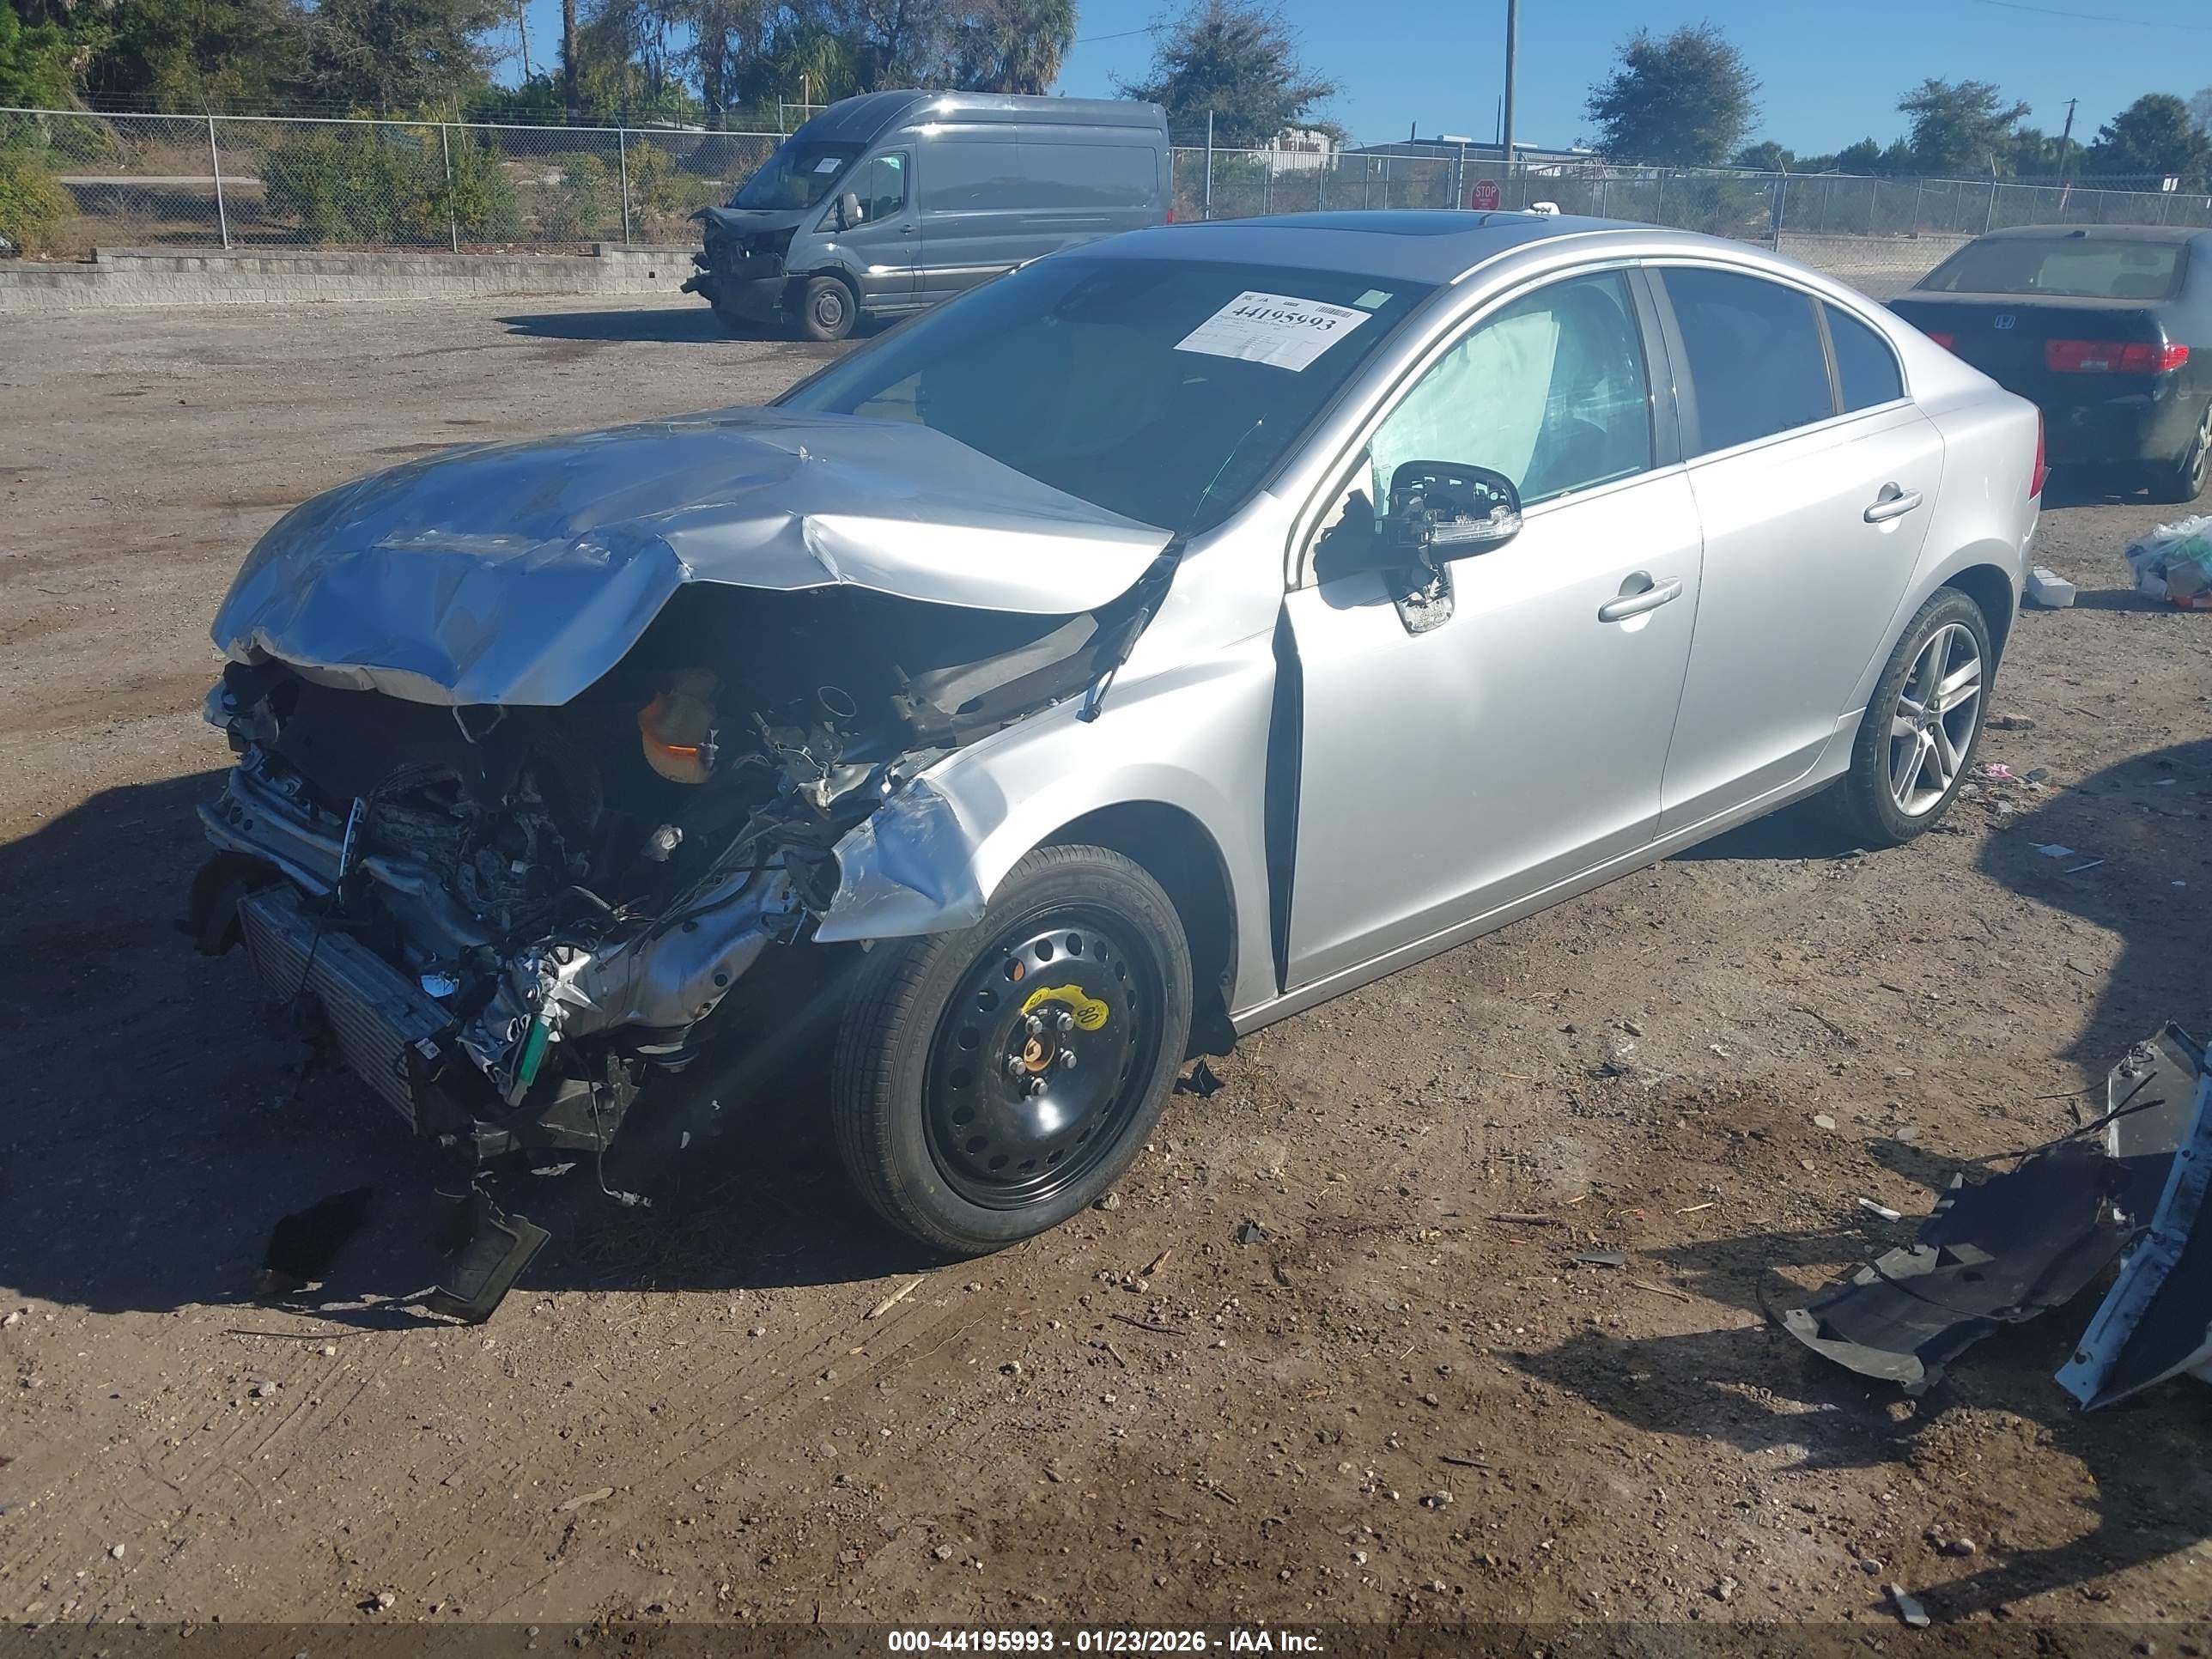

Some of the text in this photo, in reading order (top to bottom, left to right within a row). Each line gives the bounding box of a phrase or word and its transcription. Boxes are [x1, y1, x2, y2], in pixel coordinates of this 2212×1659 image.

[1476, 185, 1497, 198] STOP
[1231, 306, 1336, 331] 44195993
[1077, 1006, 1099, 1023] 80
